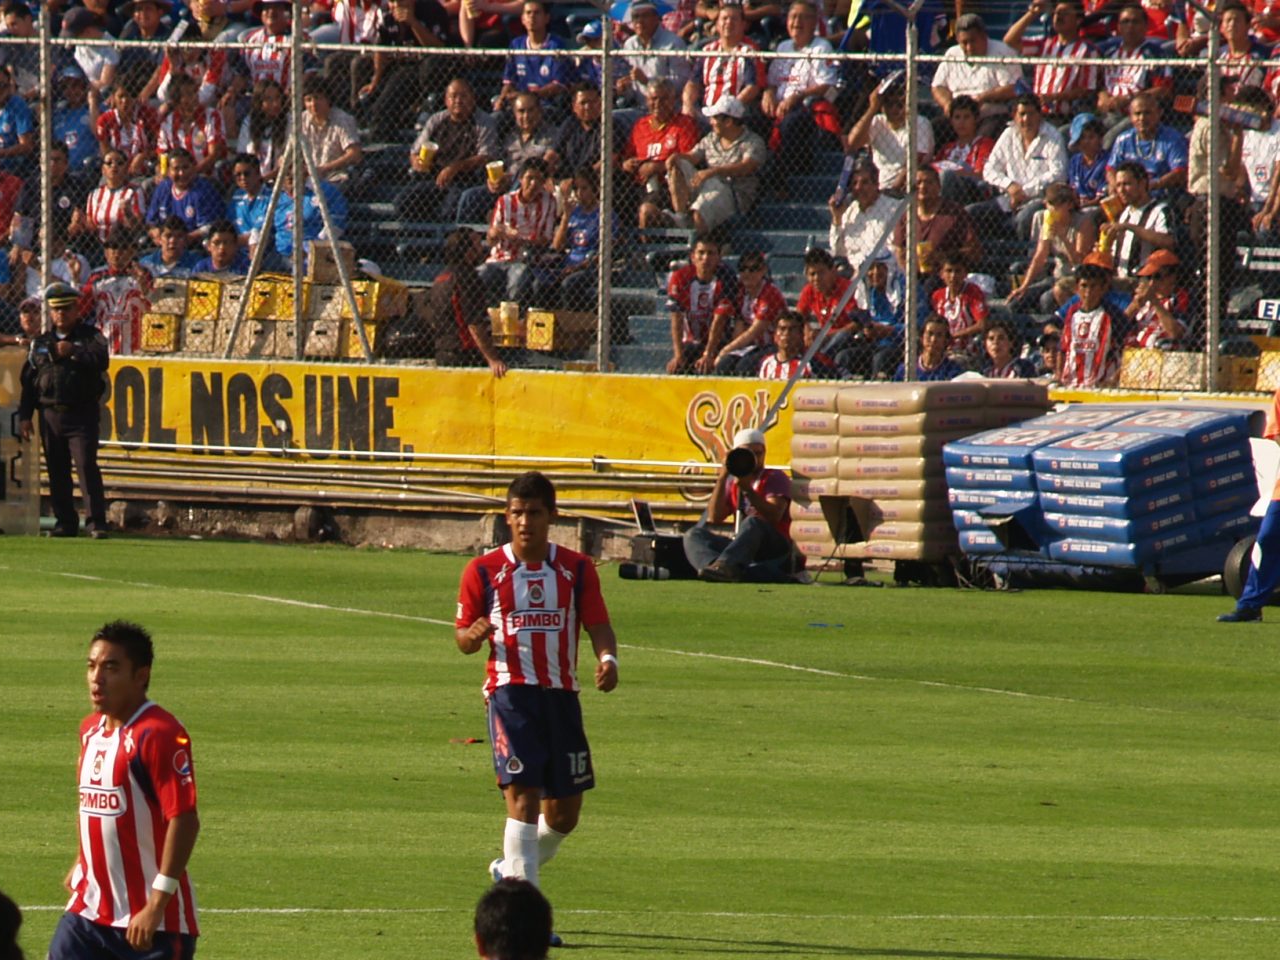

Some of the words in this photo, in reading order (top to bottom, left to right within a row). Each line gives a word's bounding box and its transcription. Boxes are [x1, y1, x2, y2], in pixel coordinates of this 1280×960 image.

[190, 371, 293, 457] NOS
[304, 374, 414, 462] UNE.
[512, 613, 560, 628] BIMBO
[567, 752, 587, 775] 16
